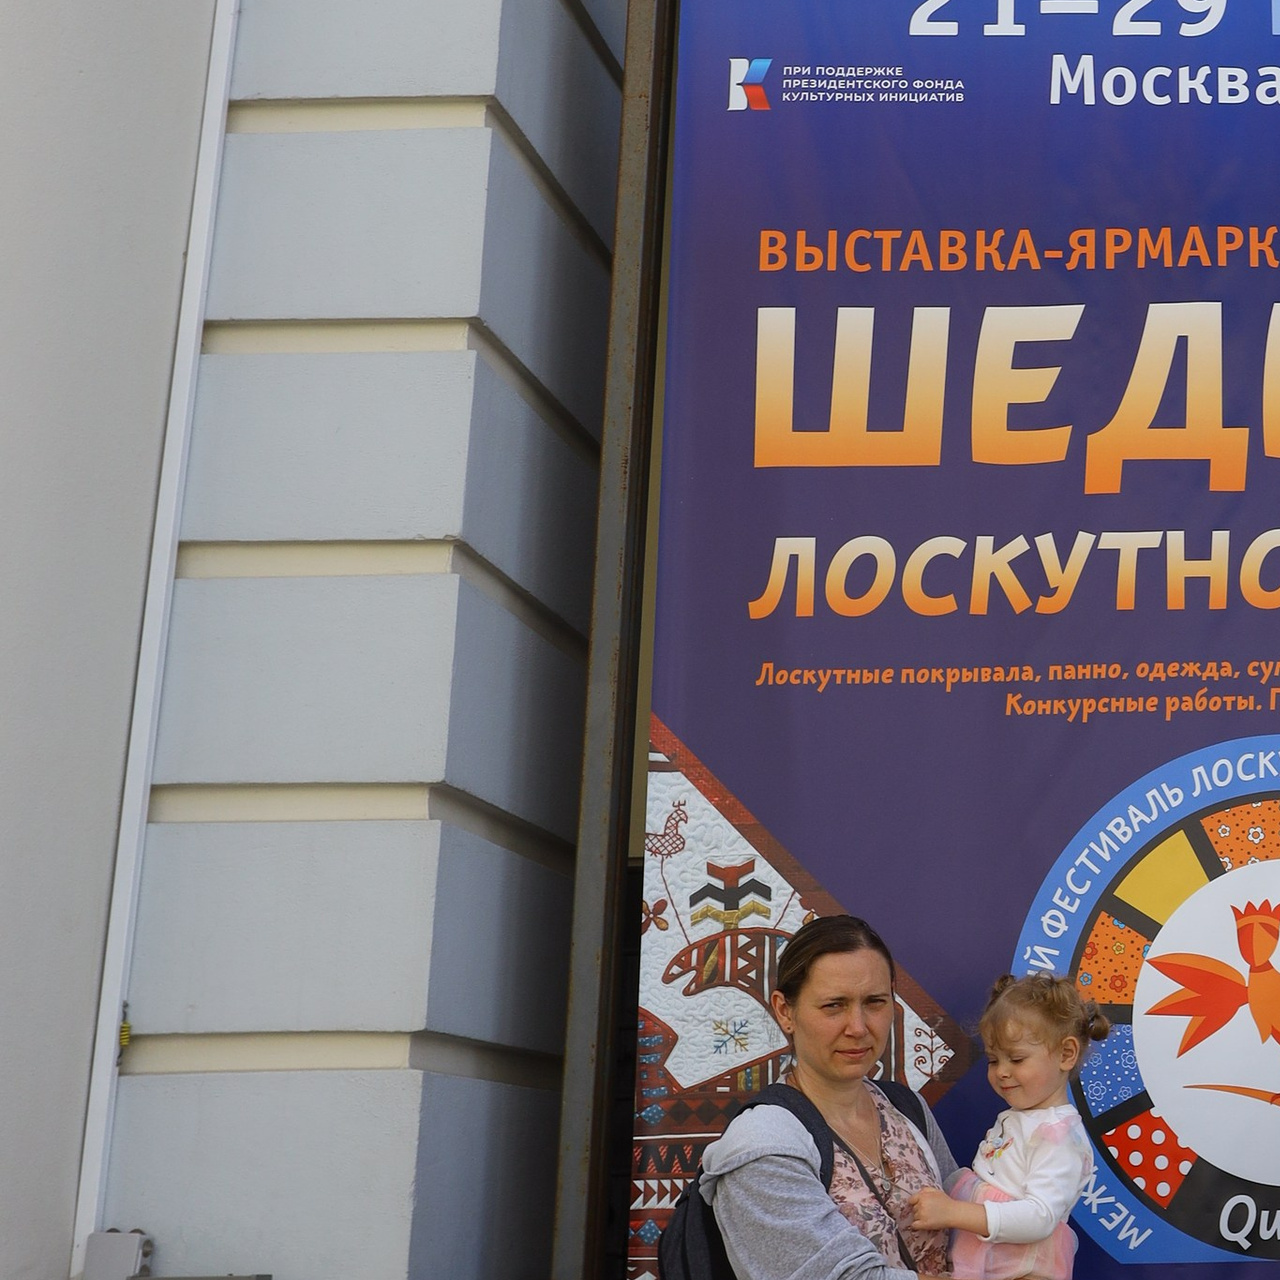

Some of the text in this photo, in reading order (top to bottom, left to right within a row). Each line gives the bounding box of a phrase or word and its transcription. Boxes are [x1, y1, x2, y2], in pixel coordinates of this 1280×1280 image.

[783, 65, 903, 77] ПРИ ПОДДЕРЖКЕ
[782, 78, 965, 91] ПРЕЗИДЕНТСКОГО ФОНДА
[782, 91, 965, 103] КУЛЬТУРНЫХ ИНИЦИАТИВ
[756, 662, 895, 693] Лоскутные
[900, 663, 1042, 693] покрывала,
[1048, 662, 1129, 684] панно,
[1135, 660, 1240, 683] одежда,
[1005, 692, 1159, 723] Конкурсные
[1165, 688, 1262, 723] работы.
[1039, 781, 1184, 941] ФЕСТИВАЛЬ
